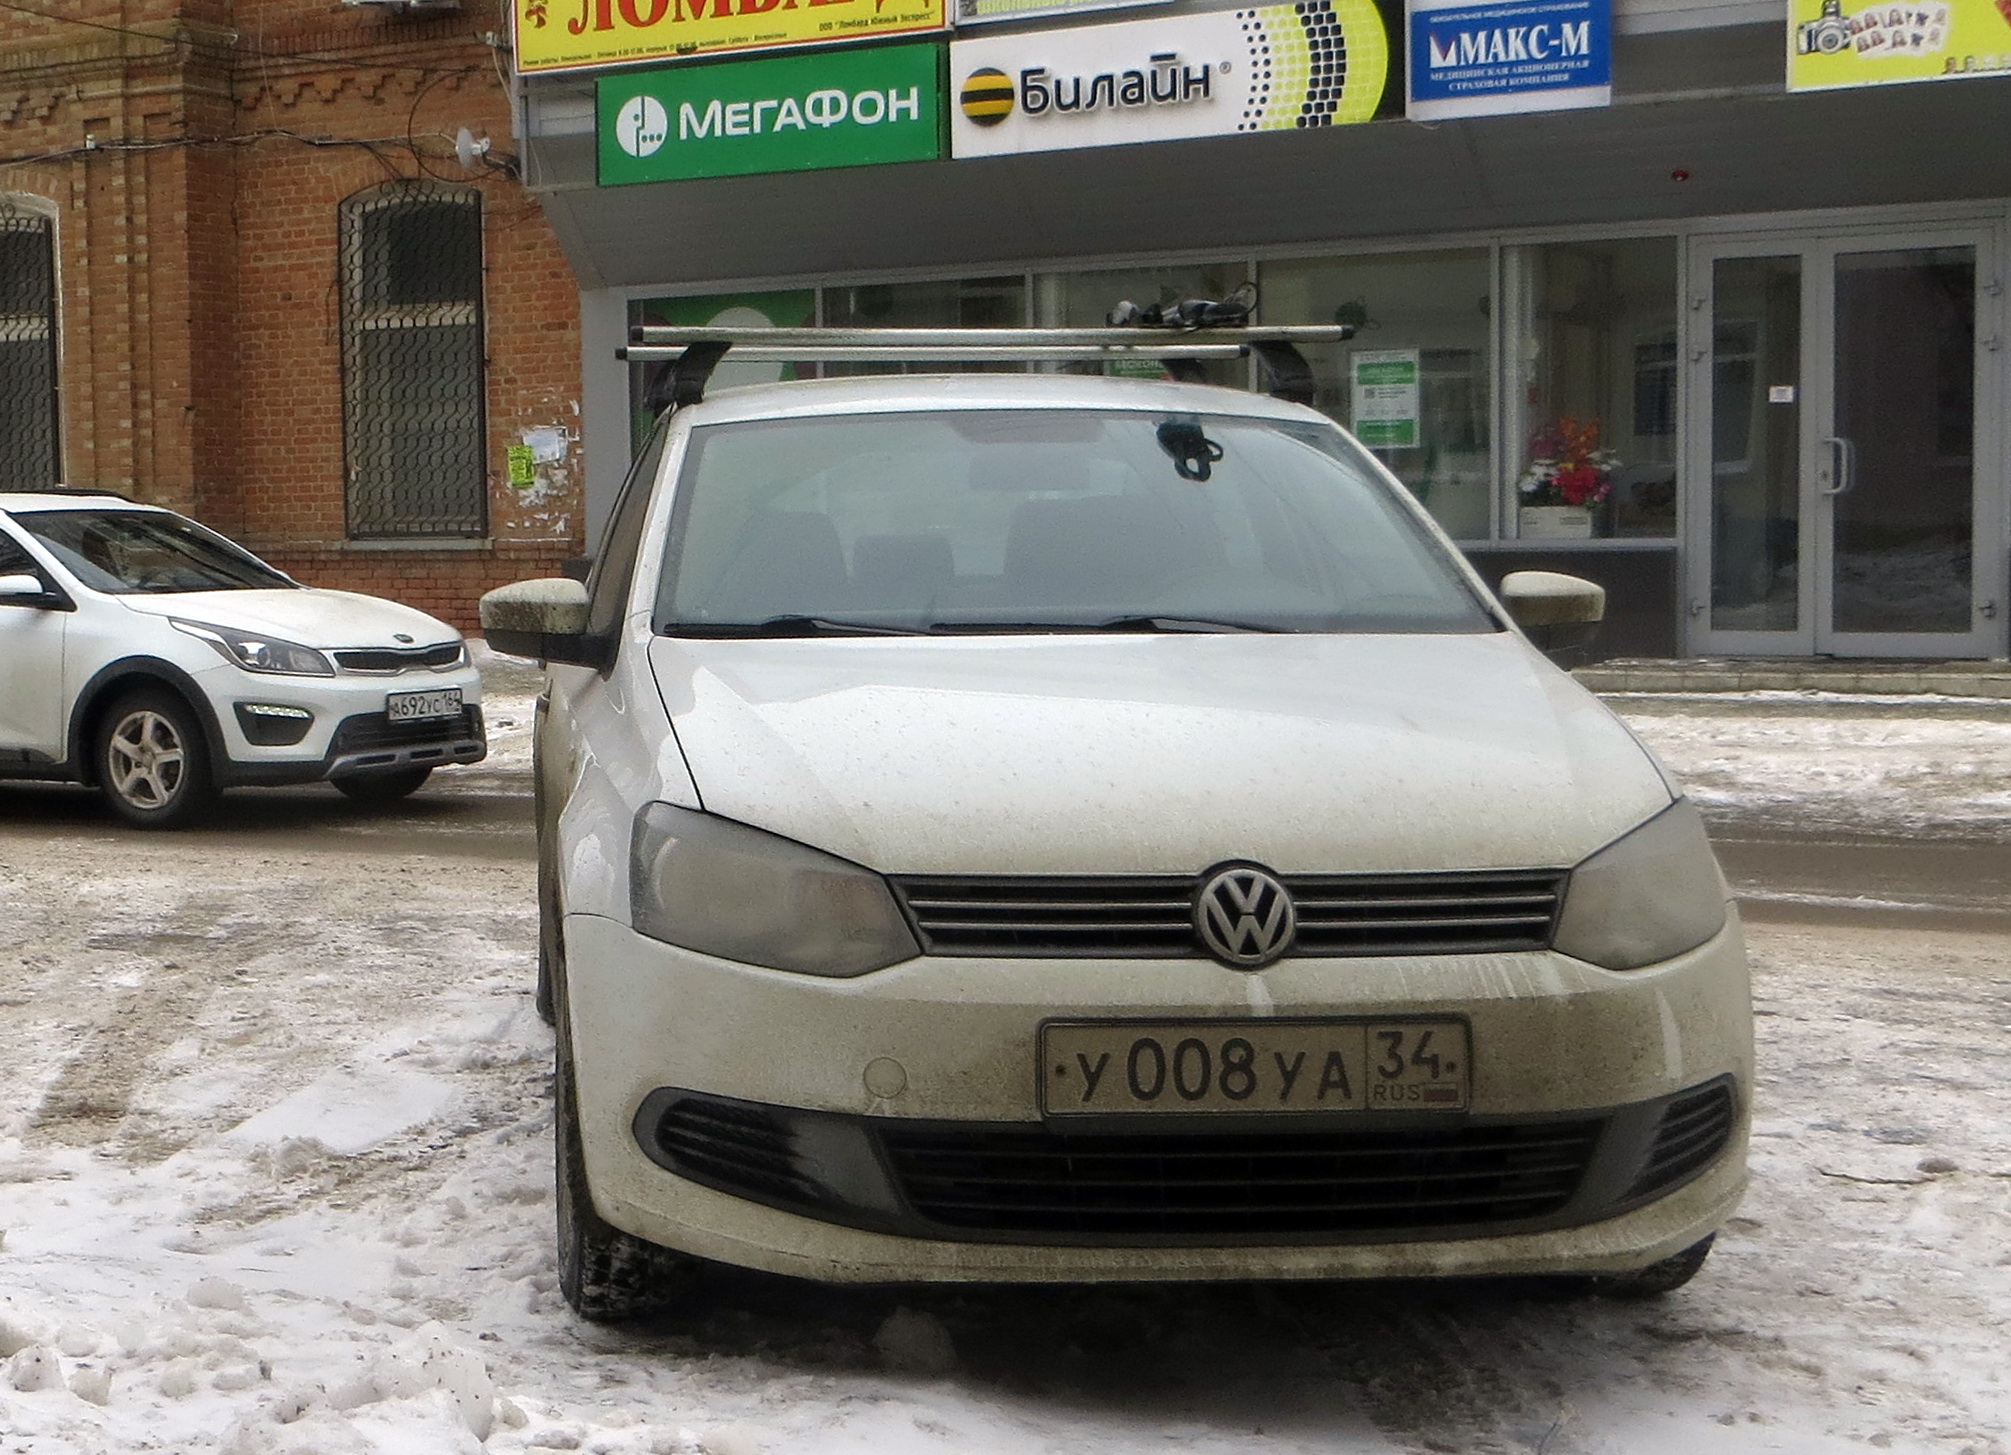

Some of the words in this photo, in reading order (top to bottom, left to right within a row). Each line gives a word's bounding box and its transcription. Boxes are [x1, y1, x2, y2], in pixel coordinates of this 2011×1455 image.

[1459, 20, 1590, 67] МАКС-М
[1020, 53, 1211, 114] Билайн
[1076, 1037, 1353, 1102] У008УА
[1377, 1031, 1440, 1079] 34
[1373, 1083, 1420, 1101] RUS
